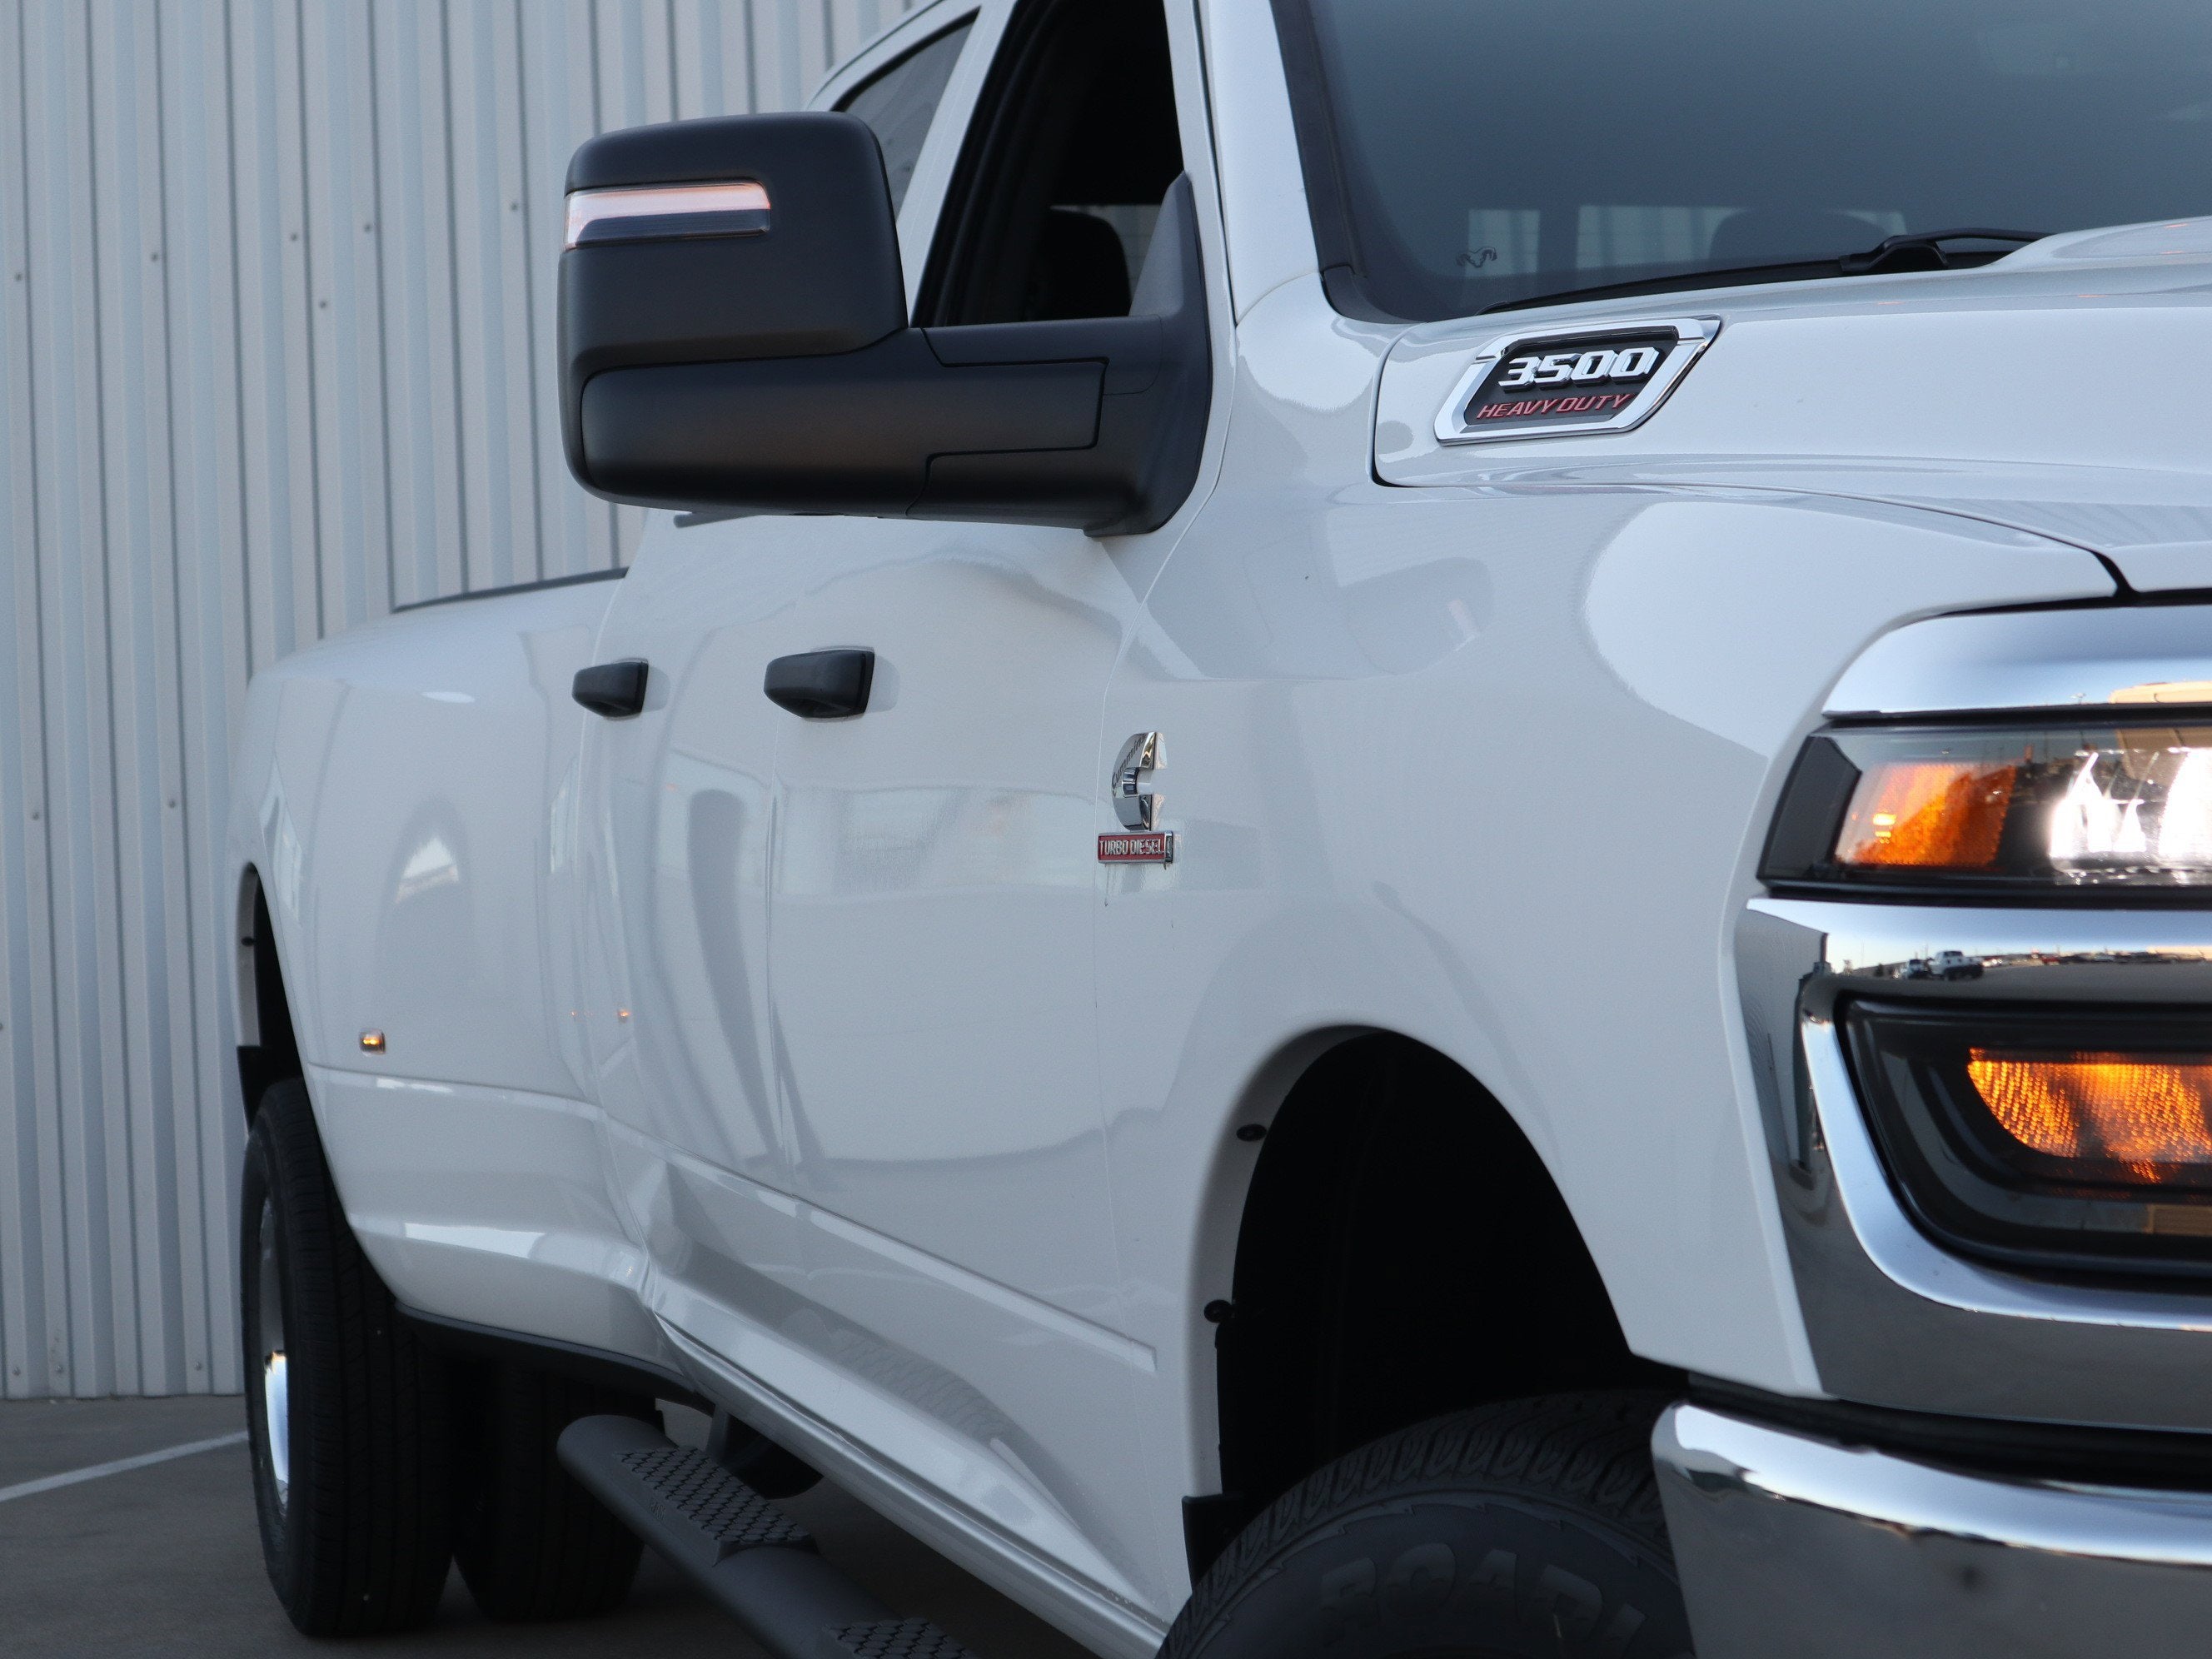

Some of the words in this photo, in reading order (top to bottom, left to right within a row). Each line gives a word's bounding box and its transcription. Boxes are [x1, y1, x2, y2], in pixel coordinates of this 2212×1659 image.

[1498, 347, 1661, 391] 3500
[1476, 397, 1557, 420] HEAVY
[1555, 393, 1634, 414] DUTY
[1099, 839, 1128, 855] TURBO
[1129, 838, 1164, 855] DIESEL
